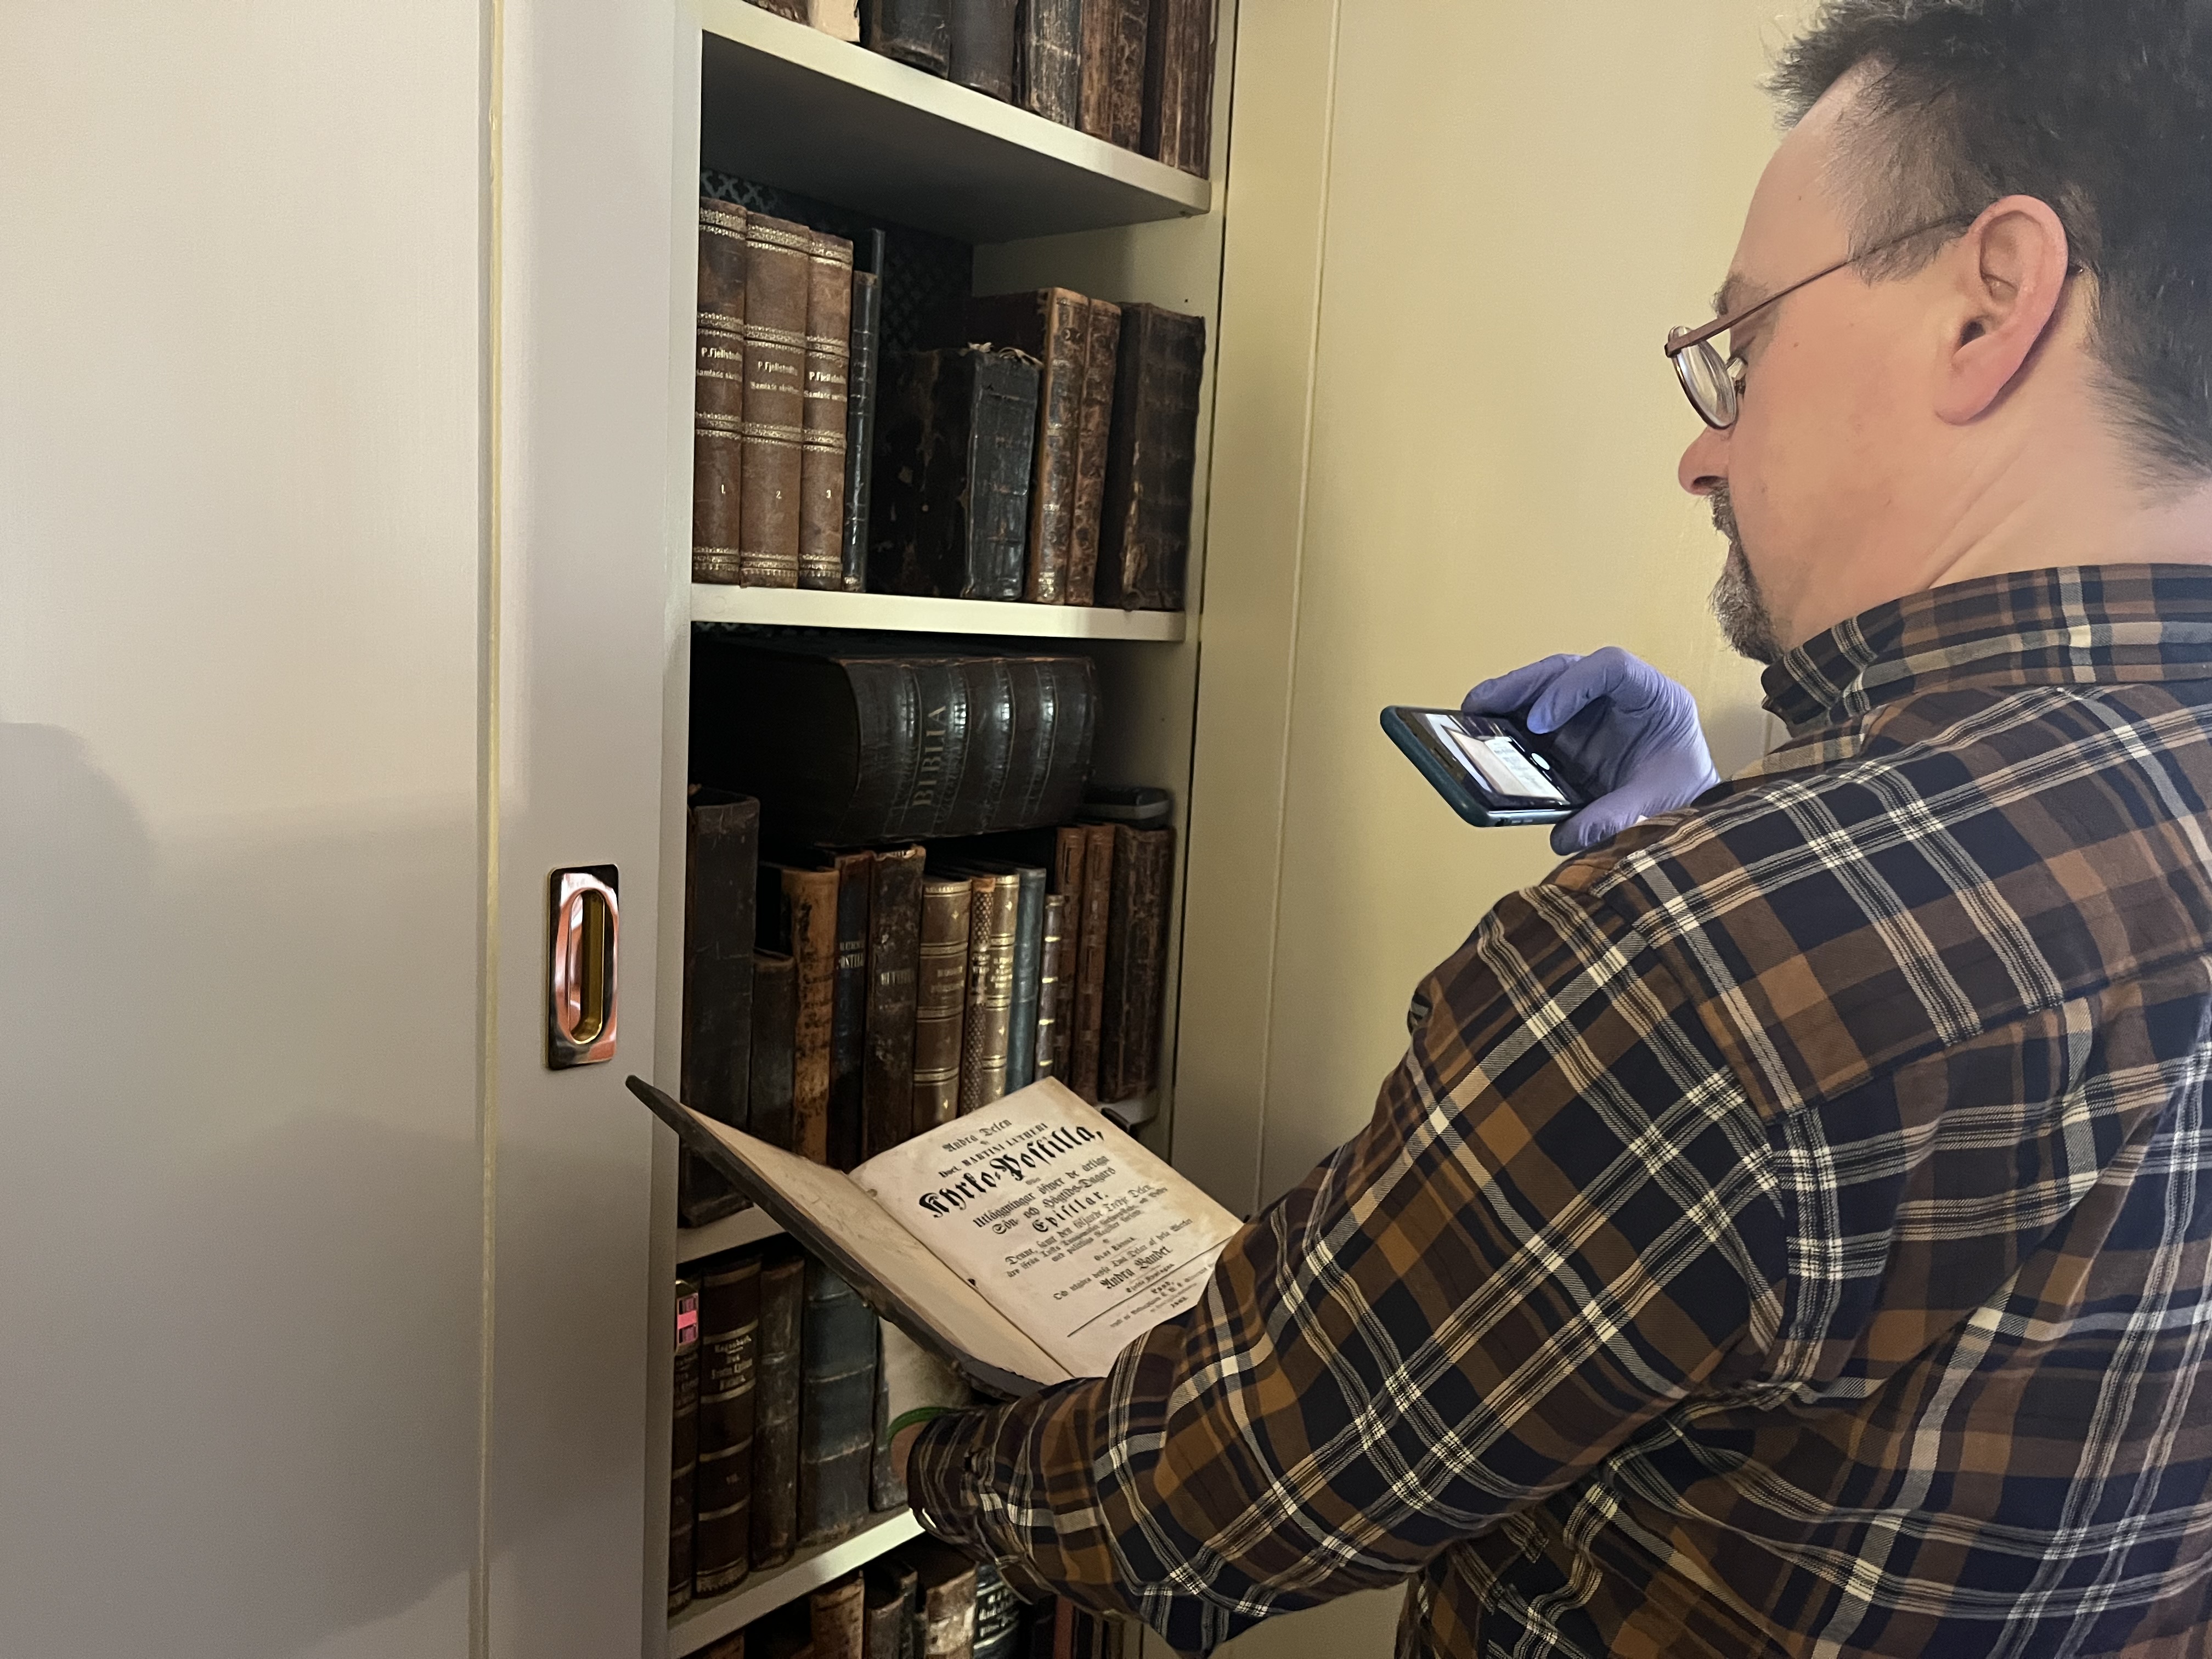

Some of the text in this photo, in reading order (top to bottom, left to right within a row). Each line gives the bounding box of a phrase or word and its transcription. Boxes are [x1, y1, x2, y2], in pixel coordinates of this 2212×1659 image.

[912, 706, 947, 806] BIBLIA
[942, 1119, 1012, 1152] Andra Delen
[1099, 1268, 1136, 1289] Andra
